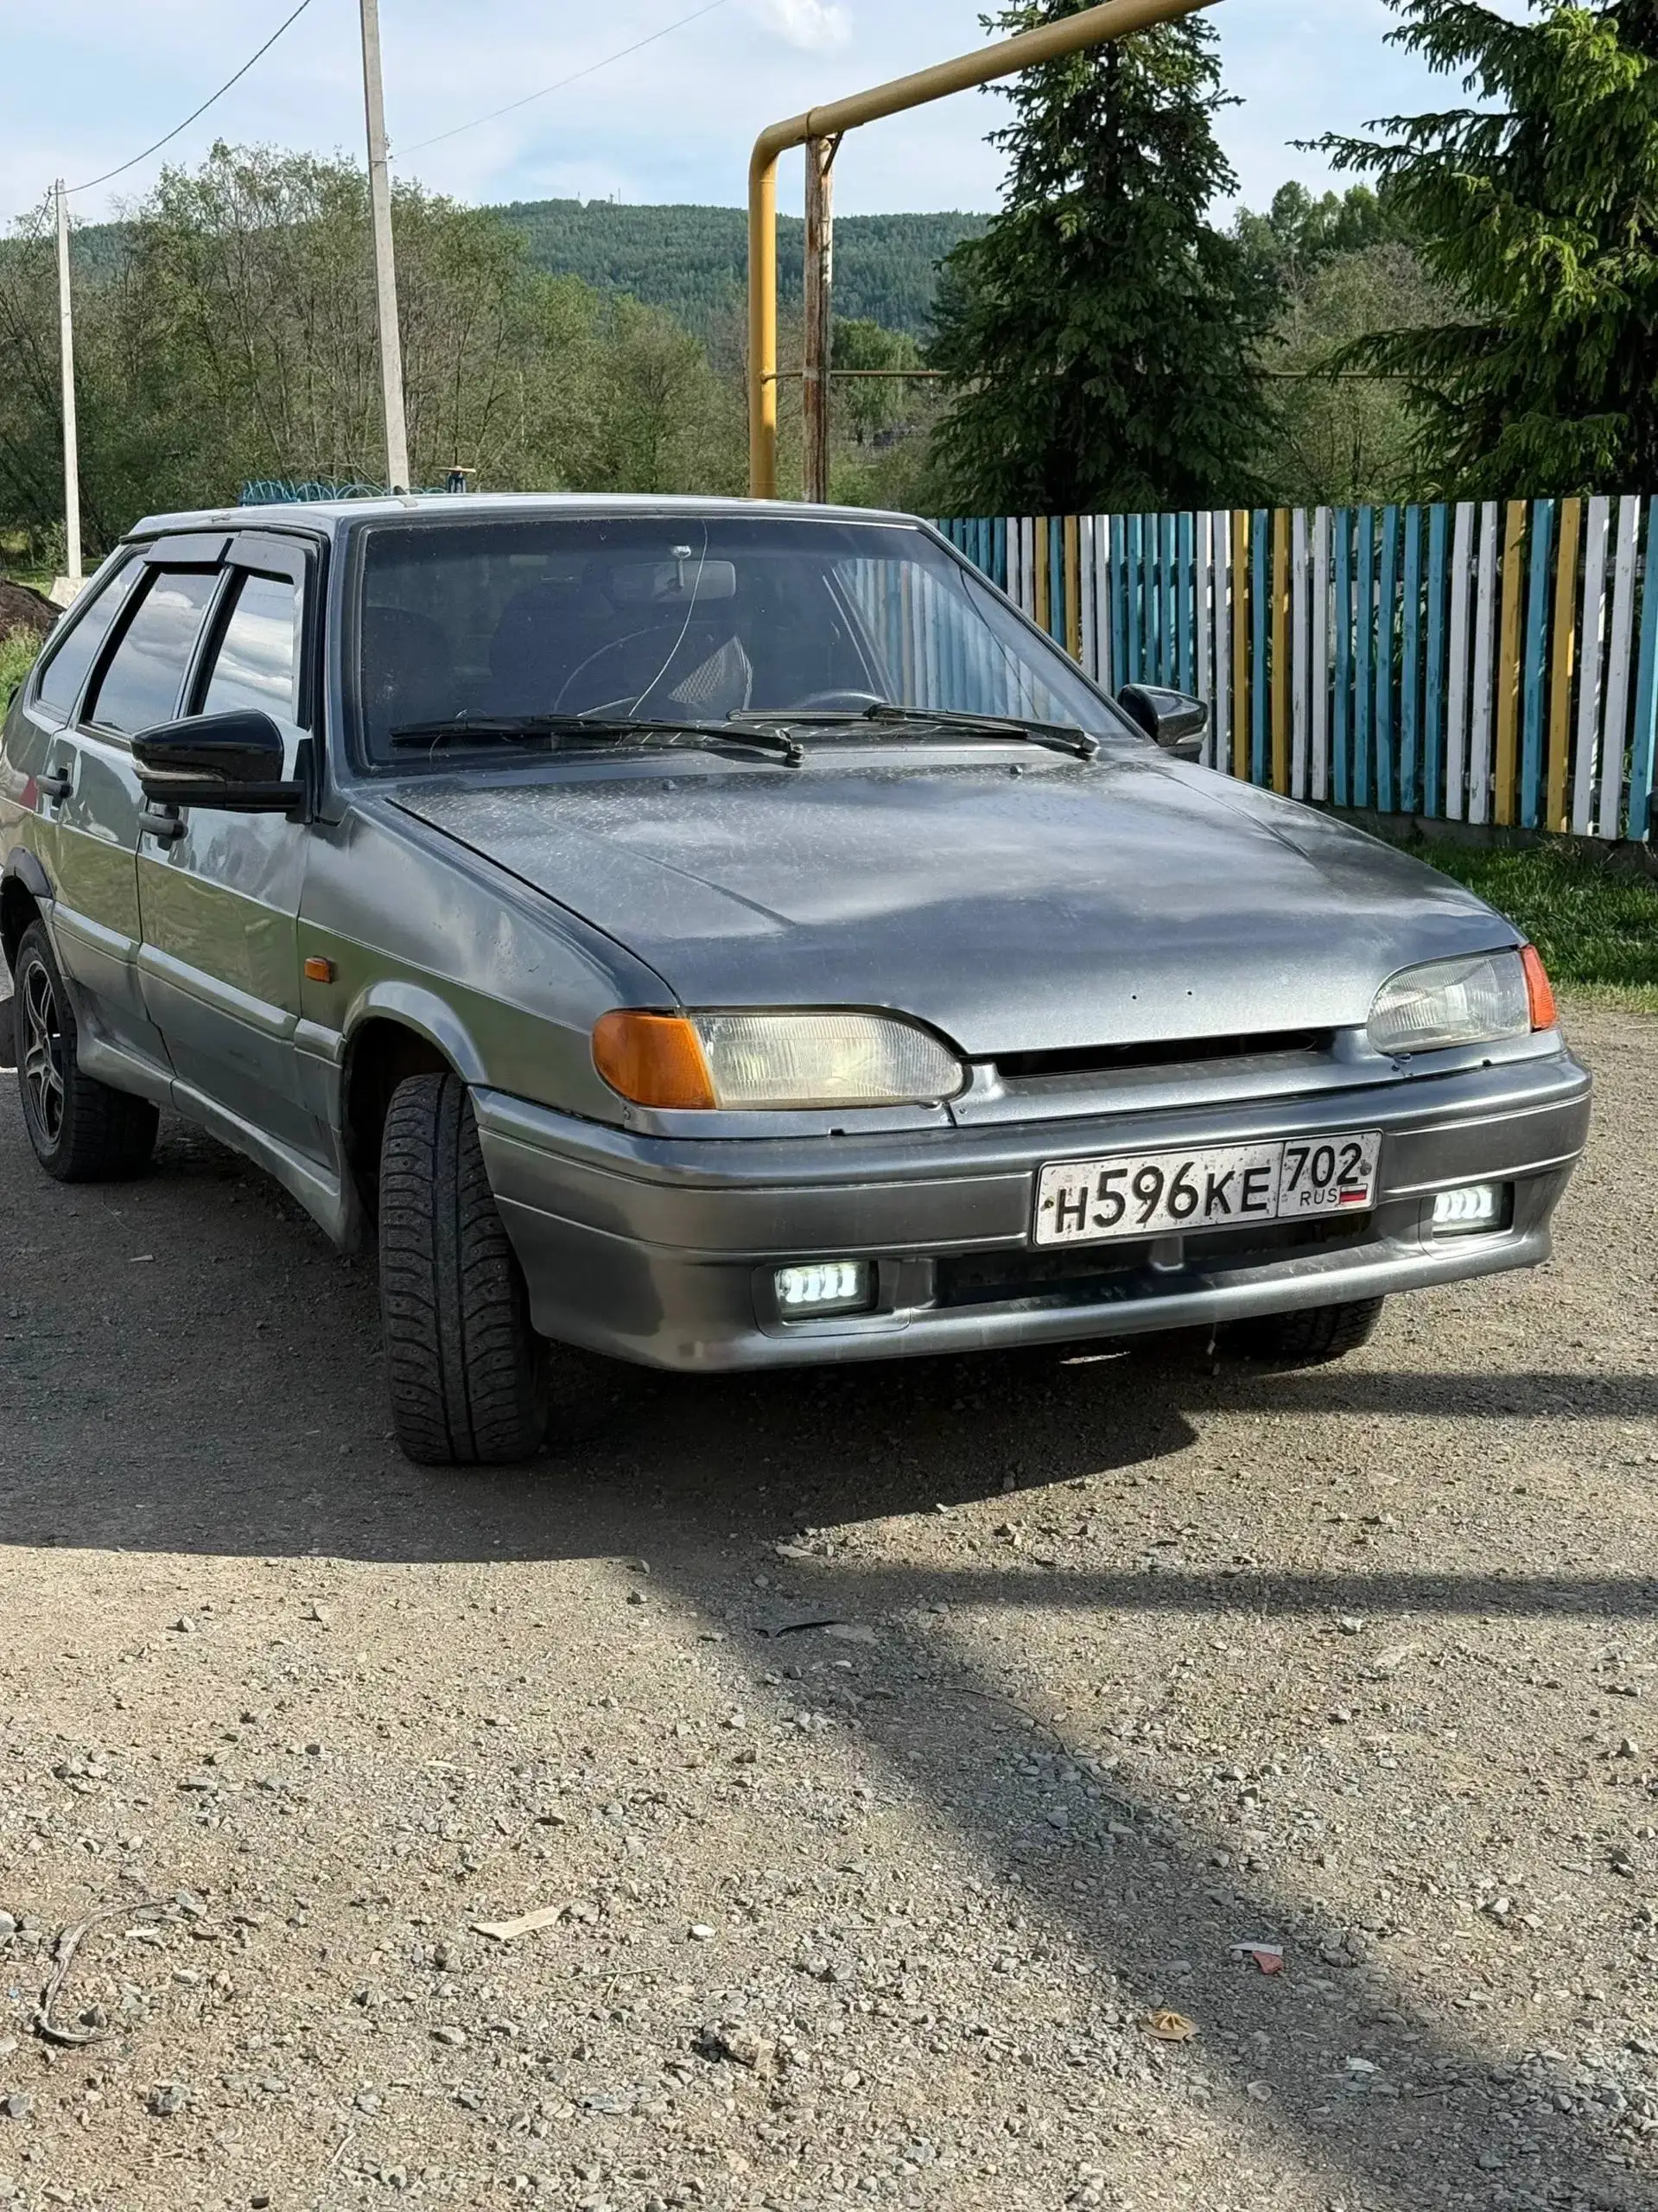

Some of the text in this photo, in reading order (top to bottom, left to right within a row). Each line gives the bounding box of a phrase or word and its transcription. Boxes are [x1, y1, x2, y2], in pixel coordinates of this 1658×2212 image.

[1056, 1142, 1363, 1233] Н596КЕ 702
[1299, 1186, 1338, 1206] RUS
